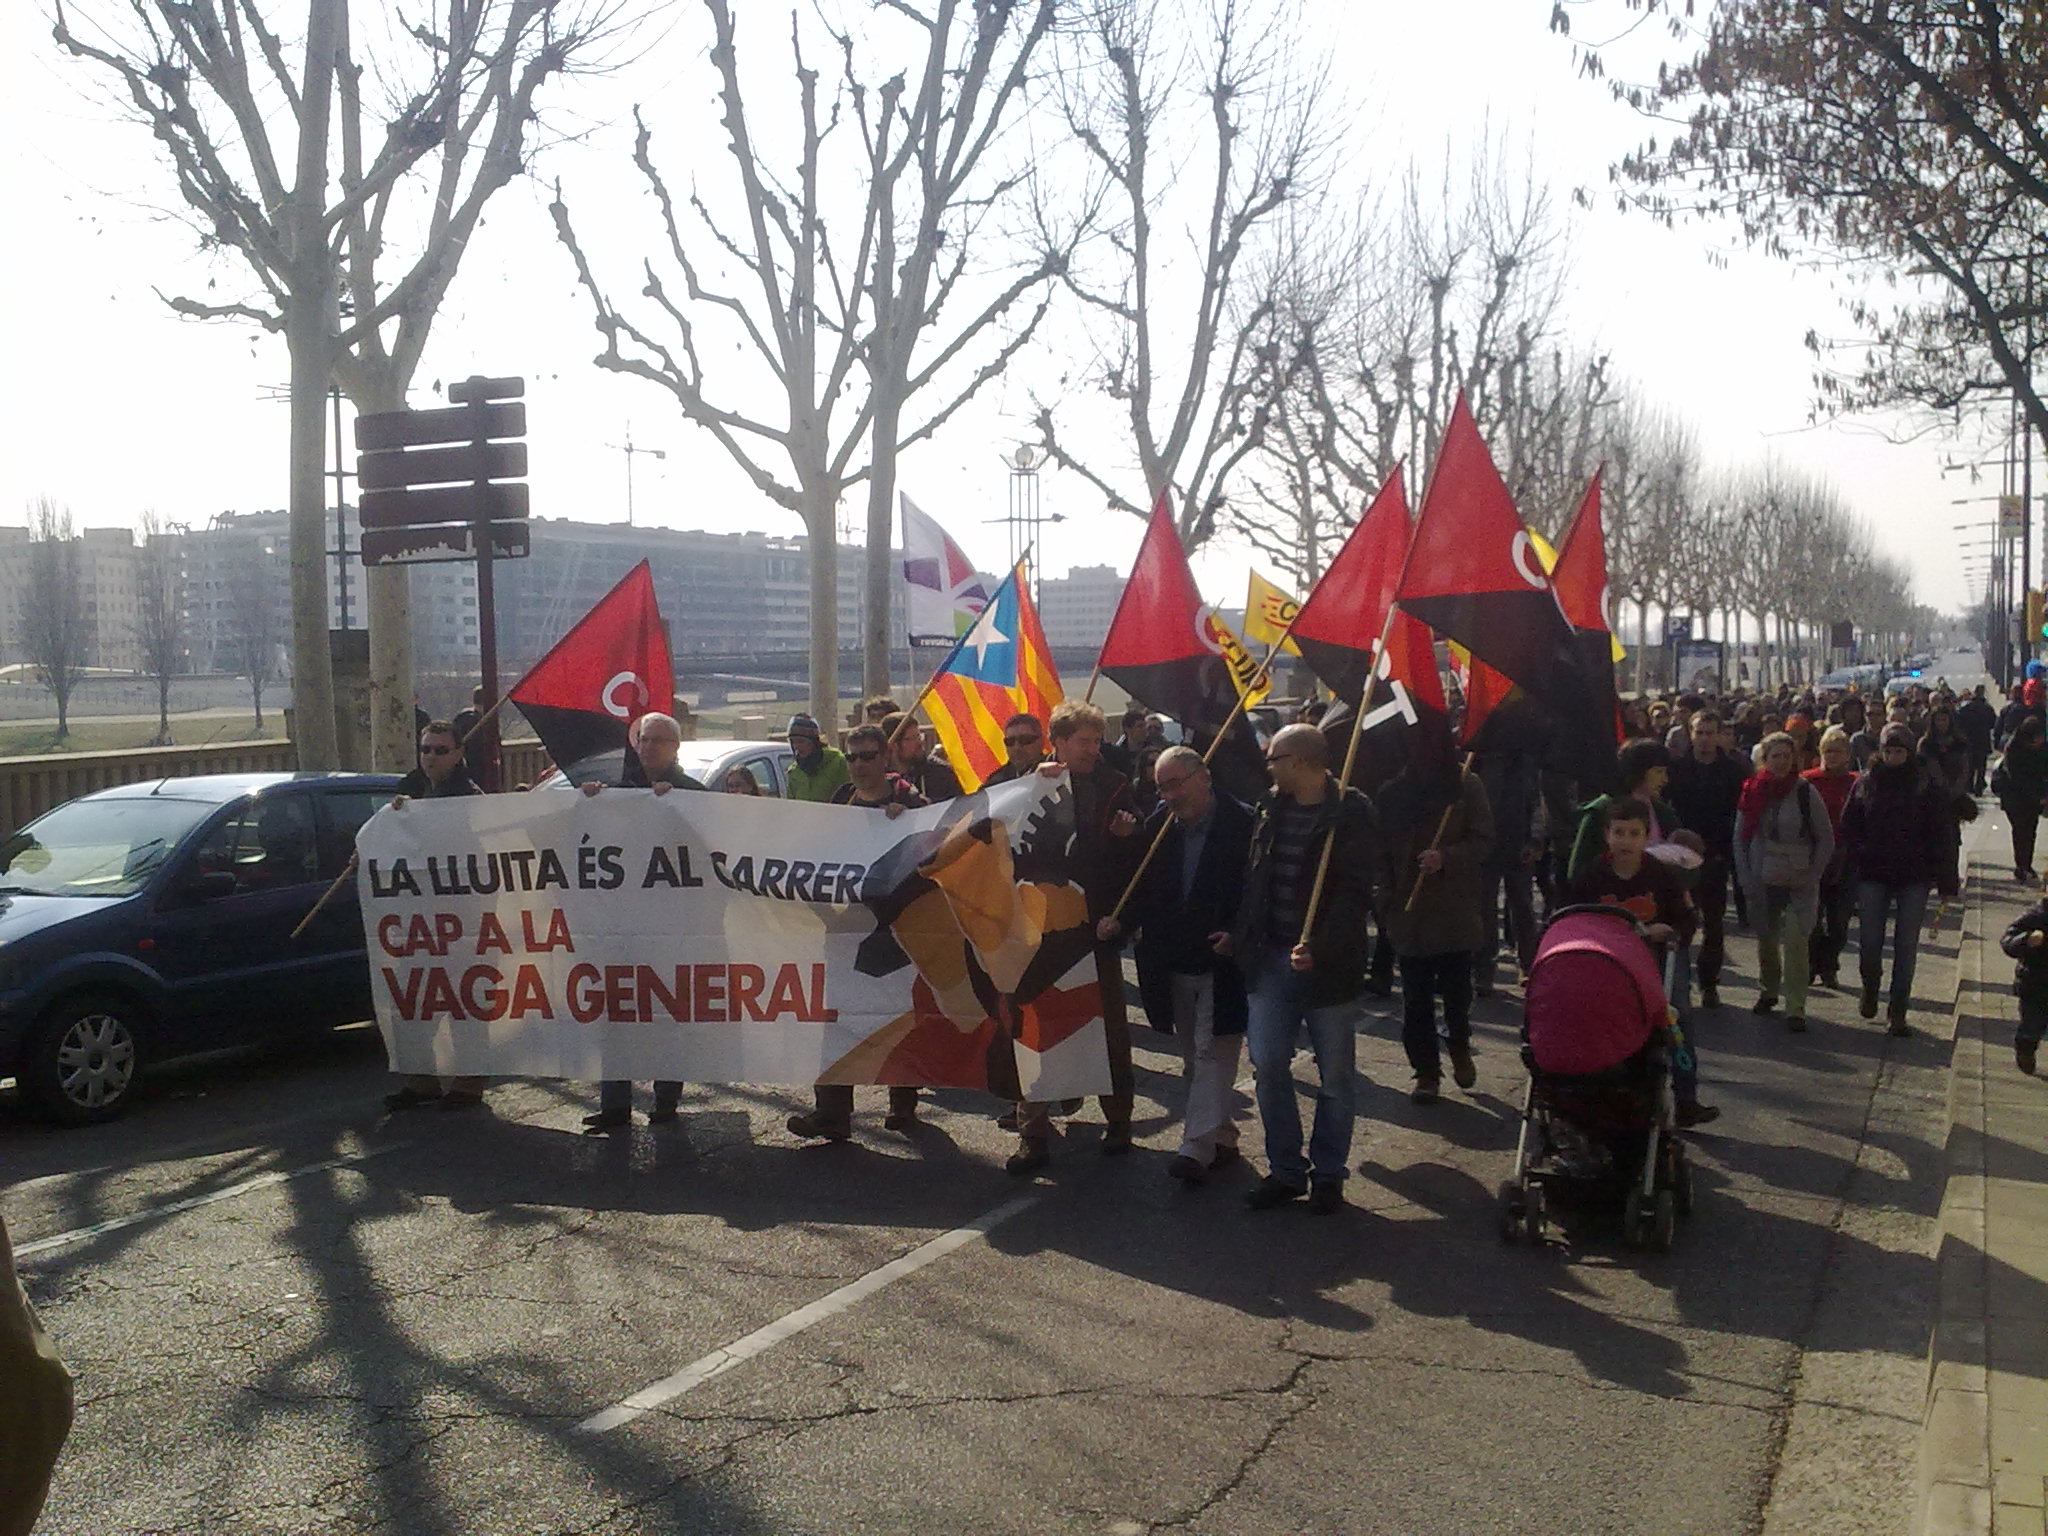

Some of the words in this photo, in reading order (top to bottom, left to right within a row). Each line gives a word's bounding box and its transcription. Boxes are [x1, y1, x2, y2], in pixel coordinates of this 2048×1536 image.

[368, 858, 422, 897] LA
[427, 848, 570, 895] LLUITA
[578, 833, 625, 890] ÉS
[641, 845, 703, 889] AL
[710, 851, 867, 903] CARRER
[378, 912, 463, 957] CAP
[475, 911, 513, 955] A
[521, 908, 575, 953] LA
[381, 963, 554, 1021] VAGA
[566, 962, 839, 1024] GENERAL
